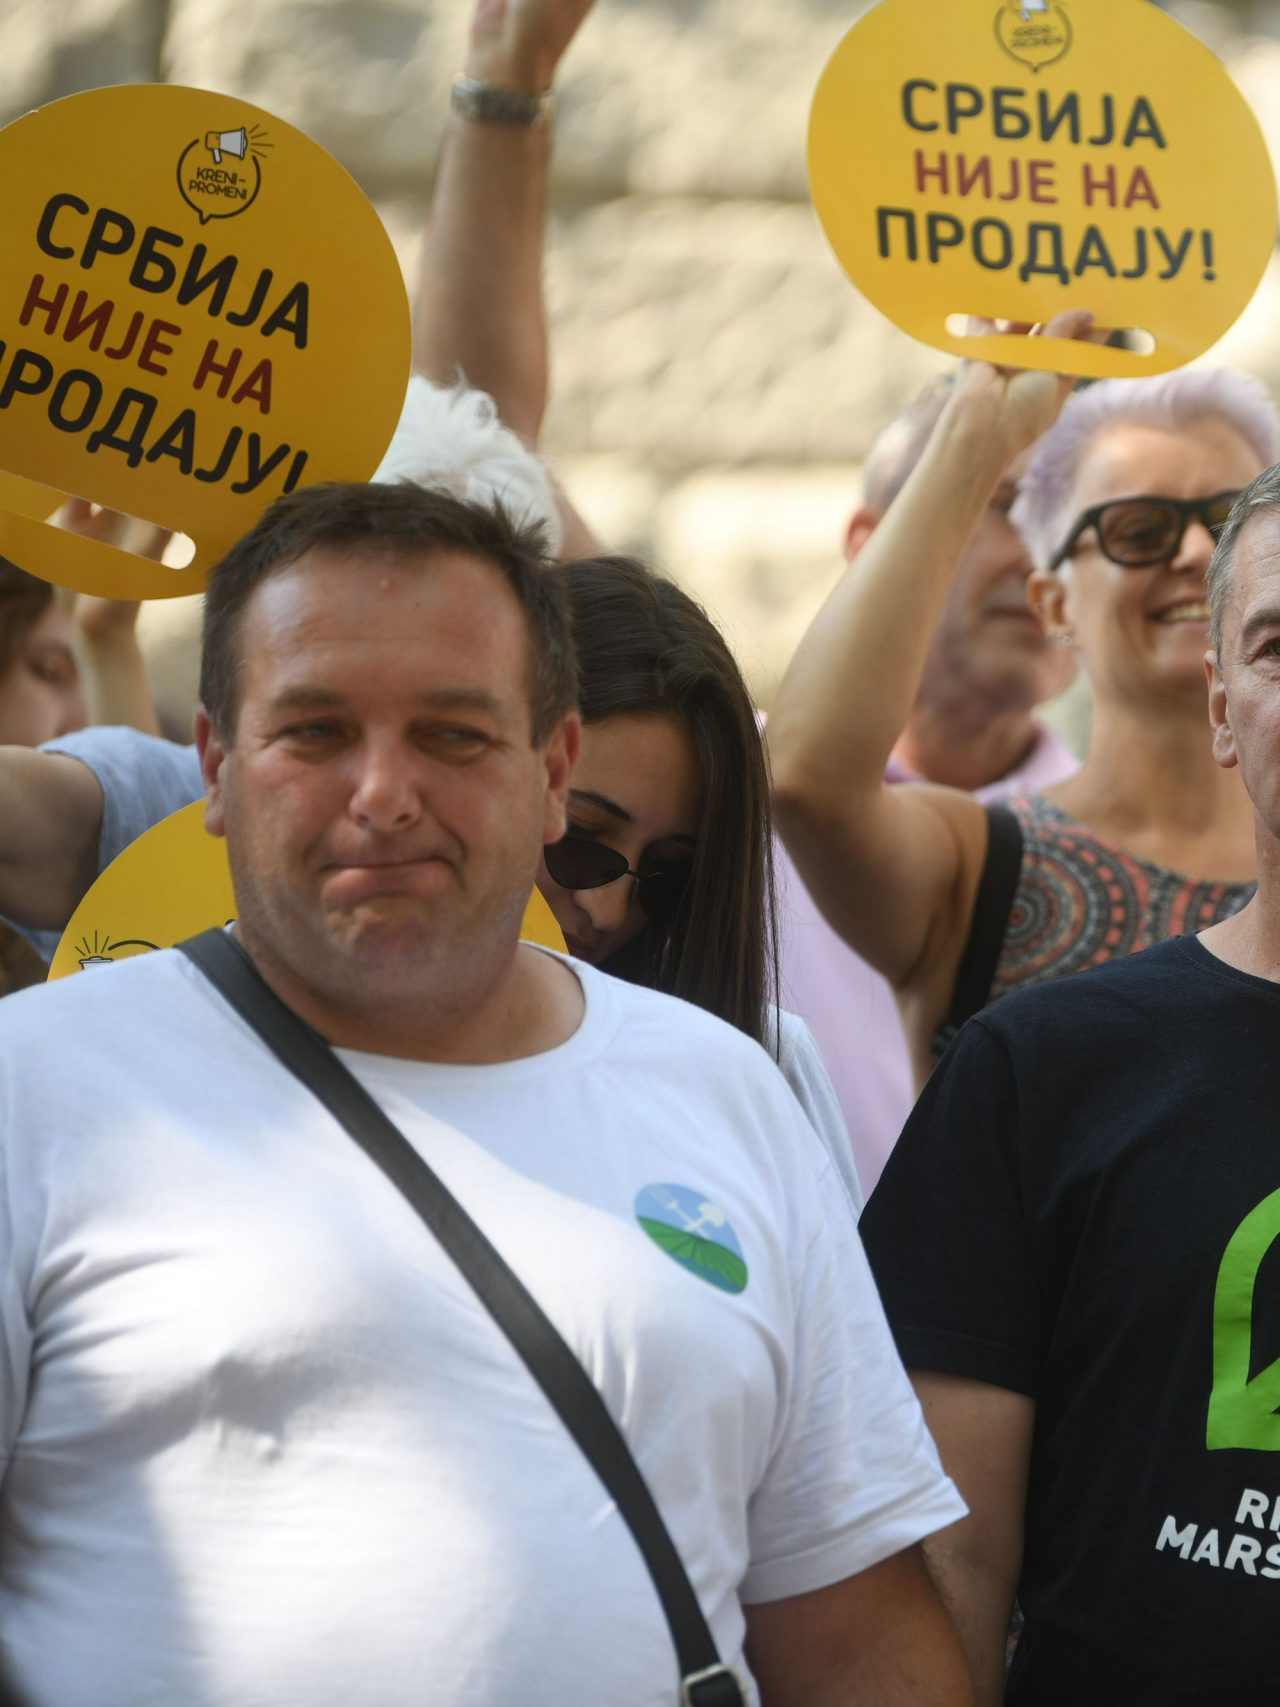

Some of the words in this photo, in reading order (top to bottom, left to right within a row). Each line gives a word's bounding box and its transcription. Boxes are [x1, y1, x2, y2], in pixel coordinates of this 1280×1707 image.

[901, 78, 1167, 150] СРБИЈА
[189, 179, 248, 200] PROMENI
[196, 166, 247, 185] KRENI-
[914, 148, 1058, 204] НИЈЕ
[1082, 162, 1161, 210] НА
[36, 193, 309, 350] СРБИЈА
[876, 206, 1217, 286] ПРОДАЈУ!
[18, 273, 183, 376] НИЈЕ
[193, 338, 273, 415] НА
[0, 340, 309, 495] РОДАЈУ!
